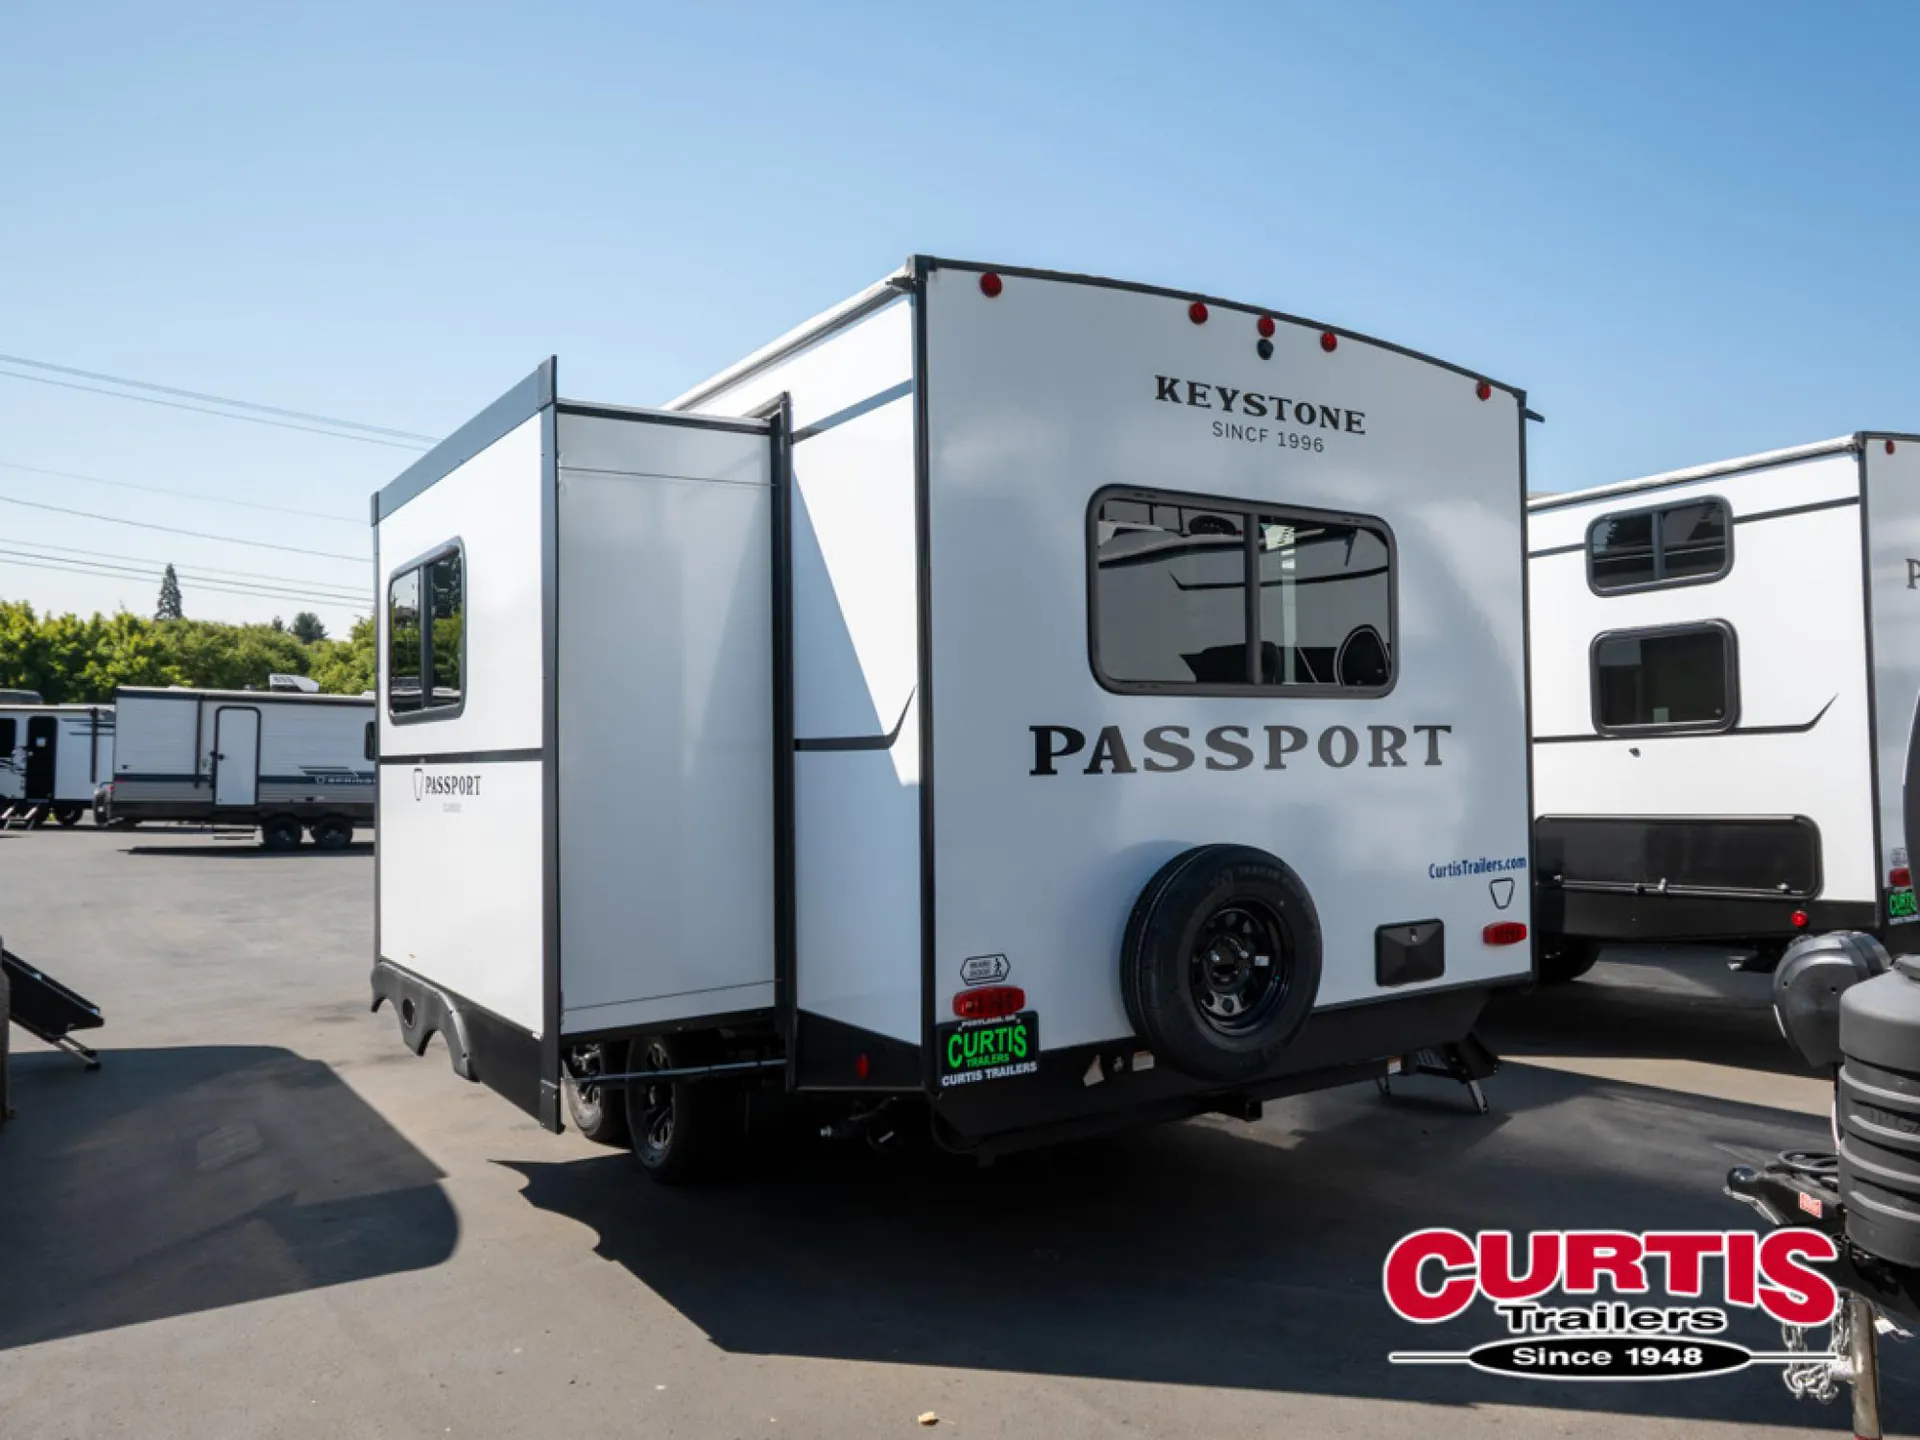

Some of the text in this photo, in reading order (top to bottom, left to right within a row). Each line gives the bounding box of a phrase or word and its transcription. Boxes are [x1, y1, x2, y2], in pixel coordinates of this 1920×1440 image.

[1154, 374, 1366, 436] KEYSTONE
[1278, 430, 1325, 453] 1996
[1028, 724, 1453, 776] PASSPORT
[425, 775, 482, 796] PASSPORT
[1428, 856, 1527, 880] CurtisTrailers.com
[947, 1024, 1028, 1069] CURTIS
[966, 1053, 1010, 1069] TRAILERS
[941, 1061, 1038, 1087] CURTIS TRAILERS
